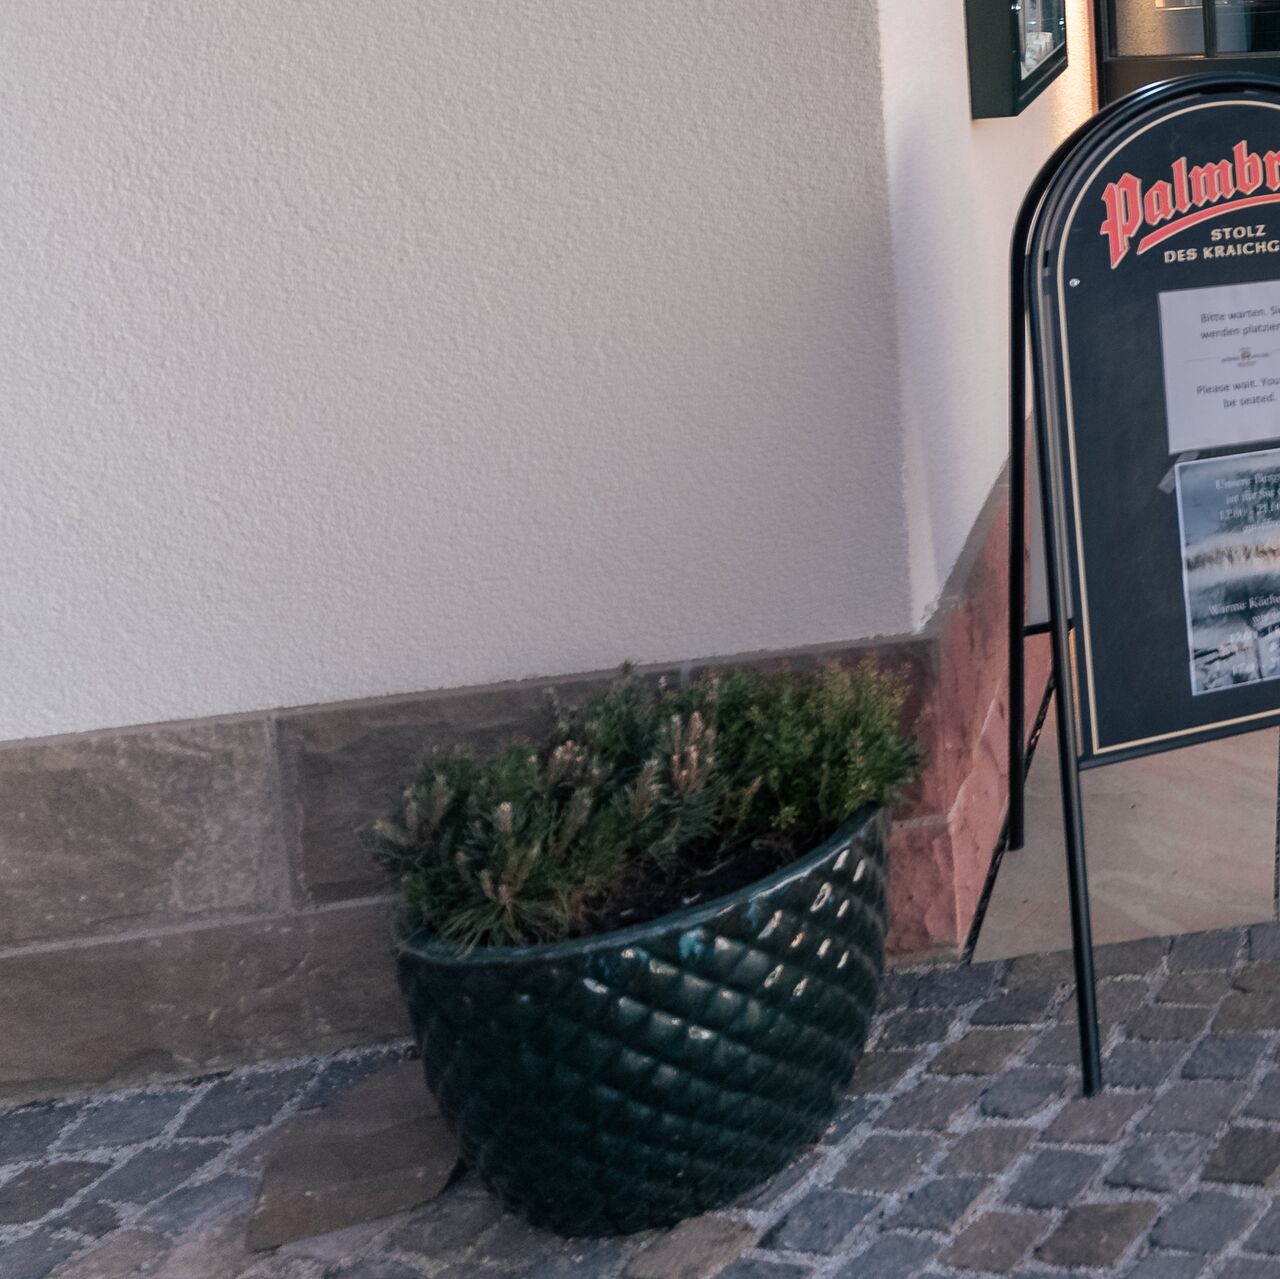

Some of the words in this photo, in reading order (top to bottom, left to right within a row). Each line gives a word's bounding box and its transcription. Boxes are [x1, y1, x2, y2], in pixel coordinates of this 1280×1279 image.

[1211, 224, 1266, 241] STOLZ
[1164, 247, 1198, 263] DES
[1200, 313, 1225, 323] Bitte
[1228, 308, 1266, 320] warten.
[1200, 327, 1240, 339] werden
[1196, 384, 1230, 394] Please
[1233, 380, 1257, 390] wait.
[1260, 377, 1280, 386] You
[1223, 399, 1238, 408] be
[1240, 393, 1277, 407] seated.
